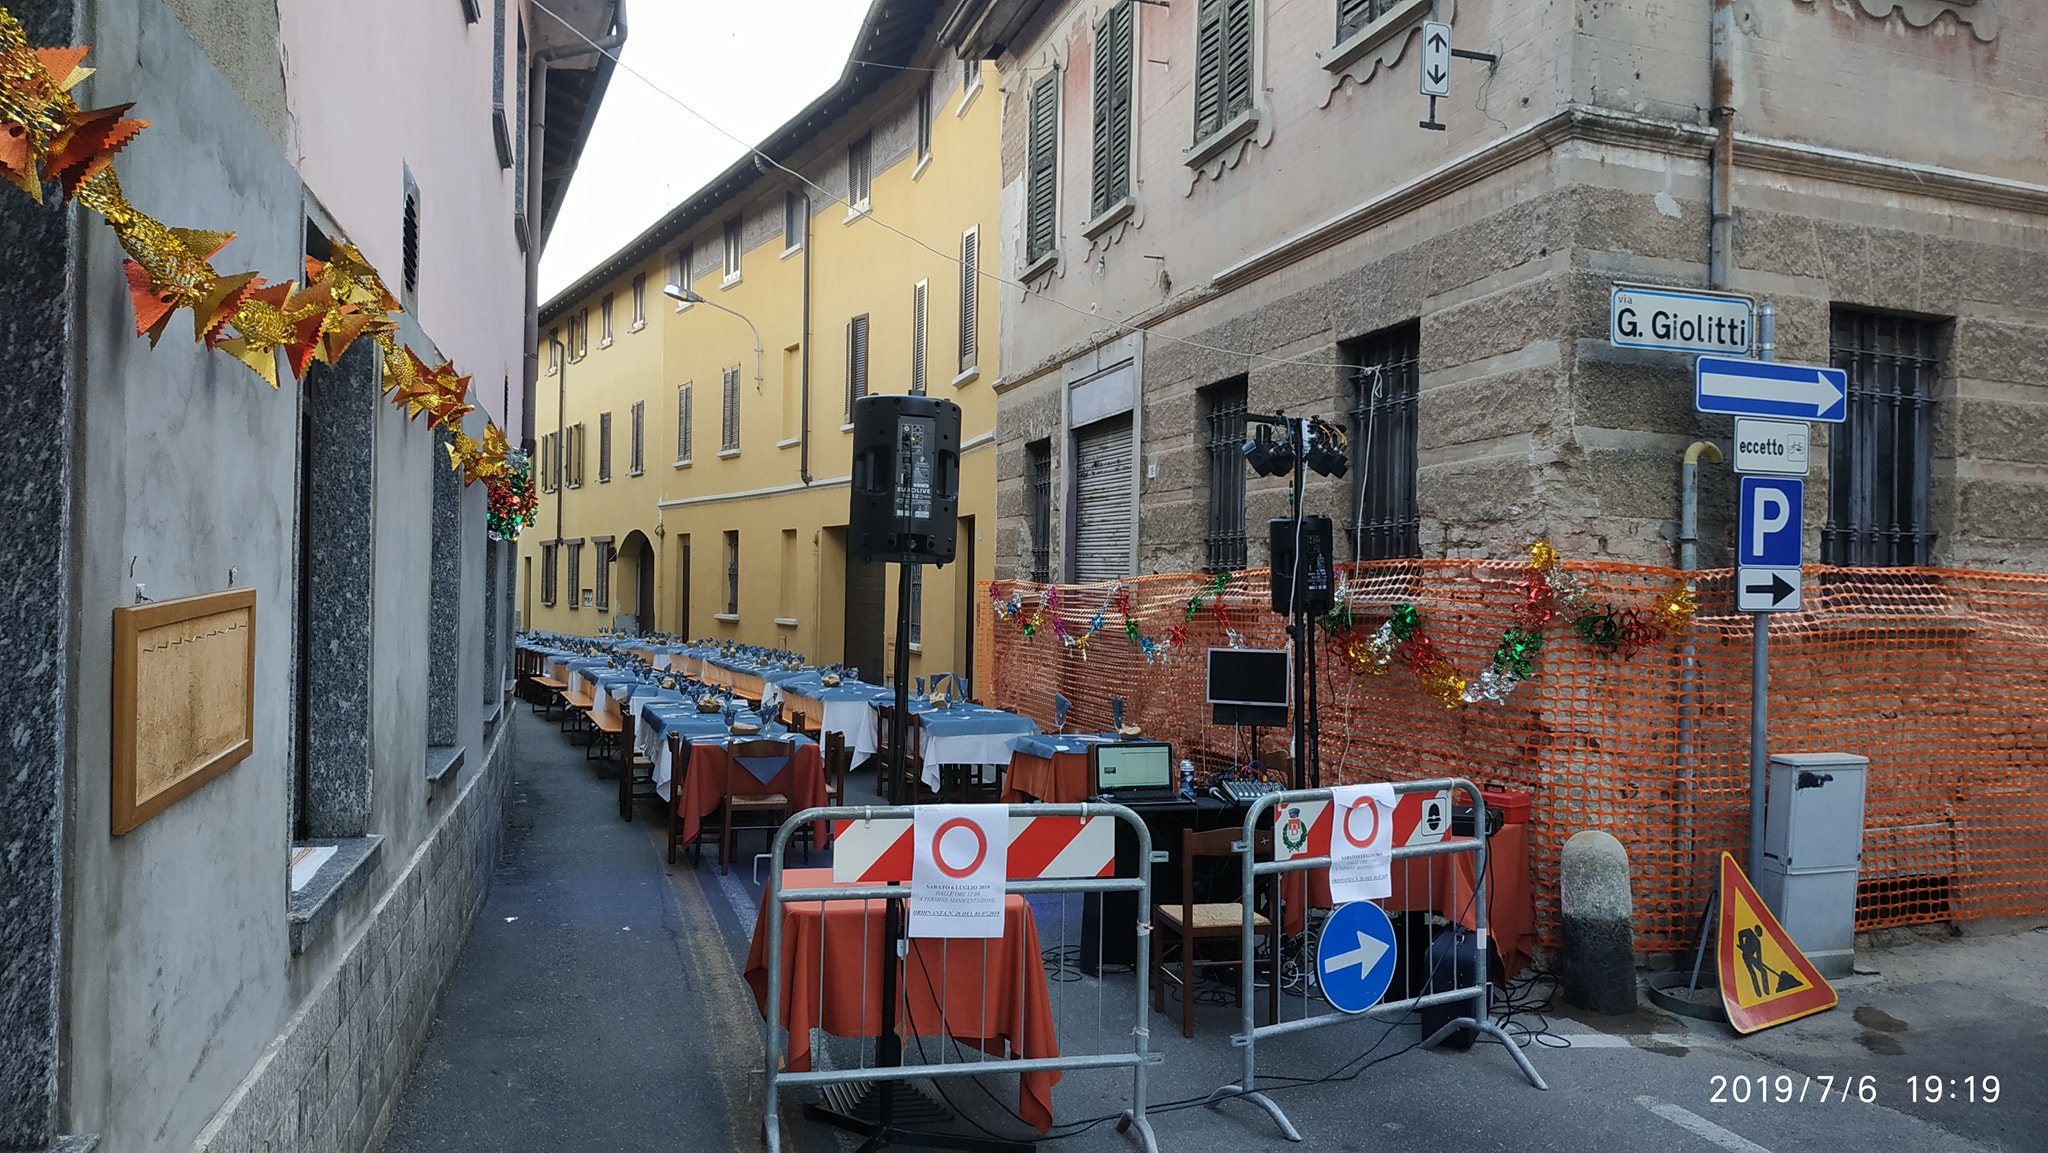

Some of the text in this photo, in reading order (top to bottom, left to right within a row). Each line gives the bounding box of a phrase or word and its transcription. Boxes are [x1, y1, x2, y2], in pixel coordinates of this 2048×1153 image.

[1618, 295, 1632, 304] via
[1618, 308, 1746, 346] G. Giolitti
[1740, 439, 1784, 456] eccetto
[1753, 487, 1790, 556] P
